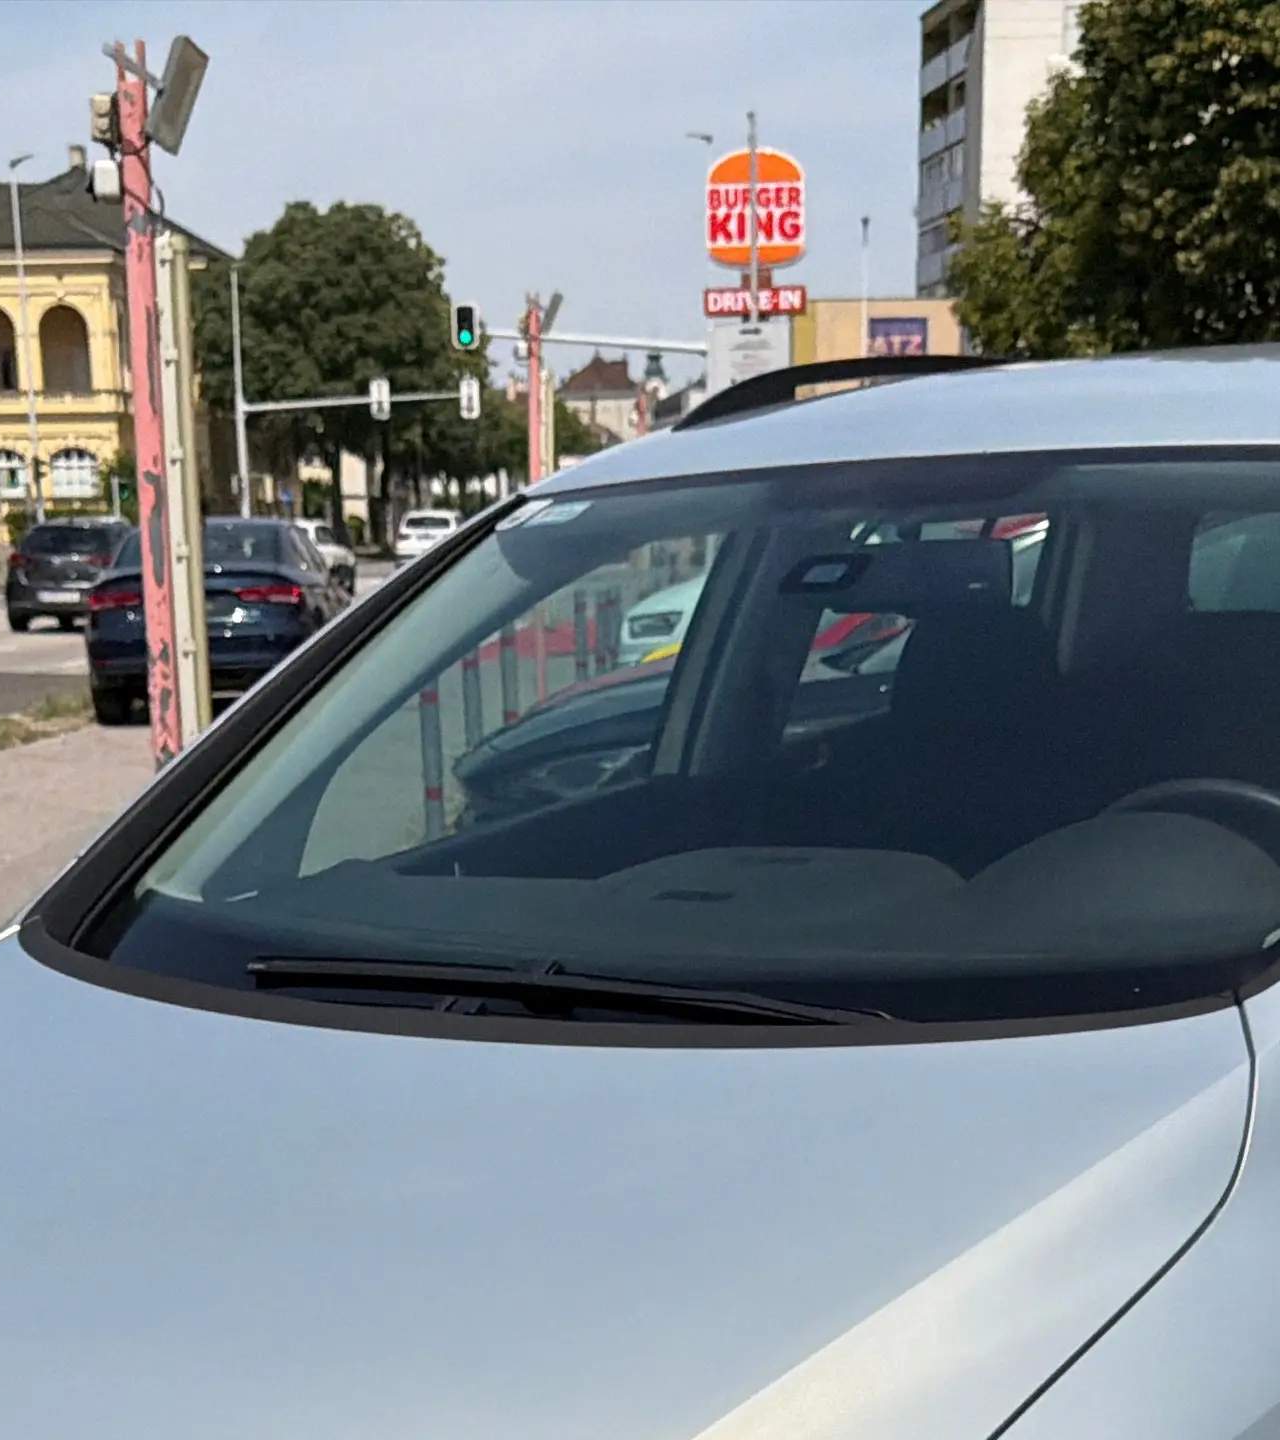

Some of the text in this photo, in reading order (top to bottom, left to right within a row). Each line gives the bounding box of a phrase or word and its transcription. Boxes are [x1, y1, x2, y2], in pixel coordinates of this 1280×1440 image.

[707, 186, 802, 210] BURGER
[709, 210, 801, 242] KING
[706, 289, 803, 314] DRIVE-IN
